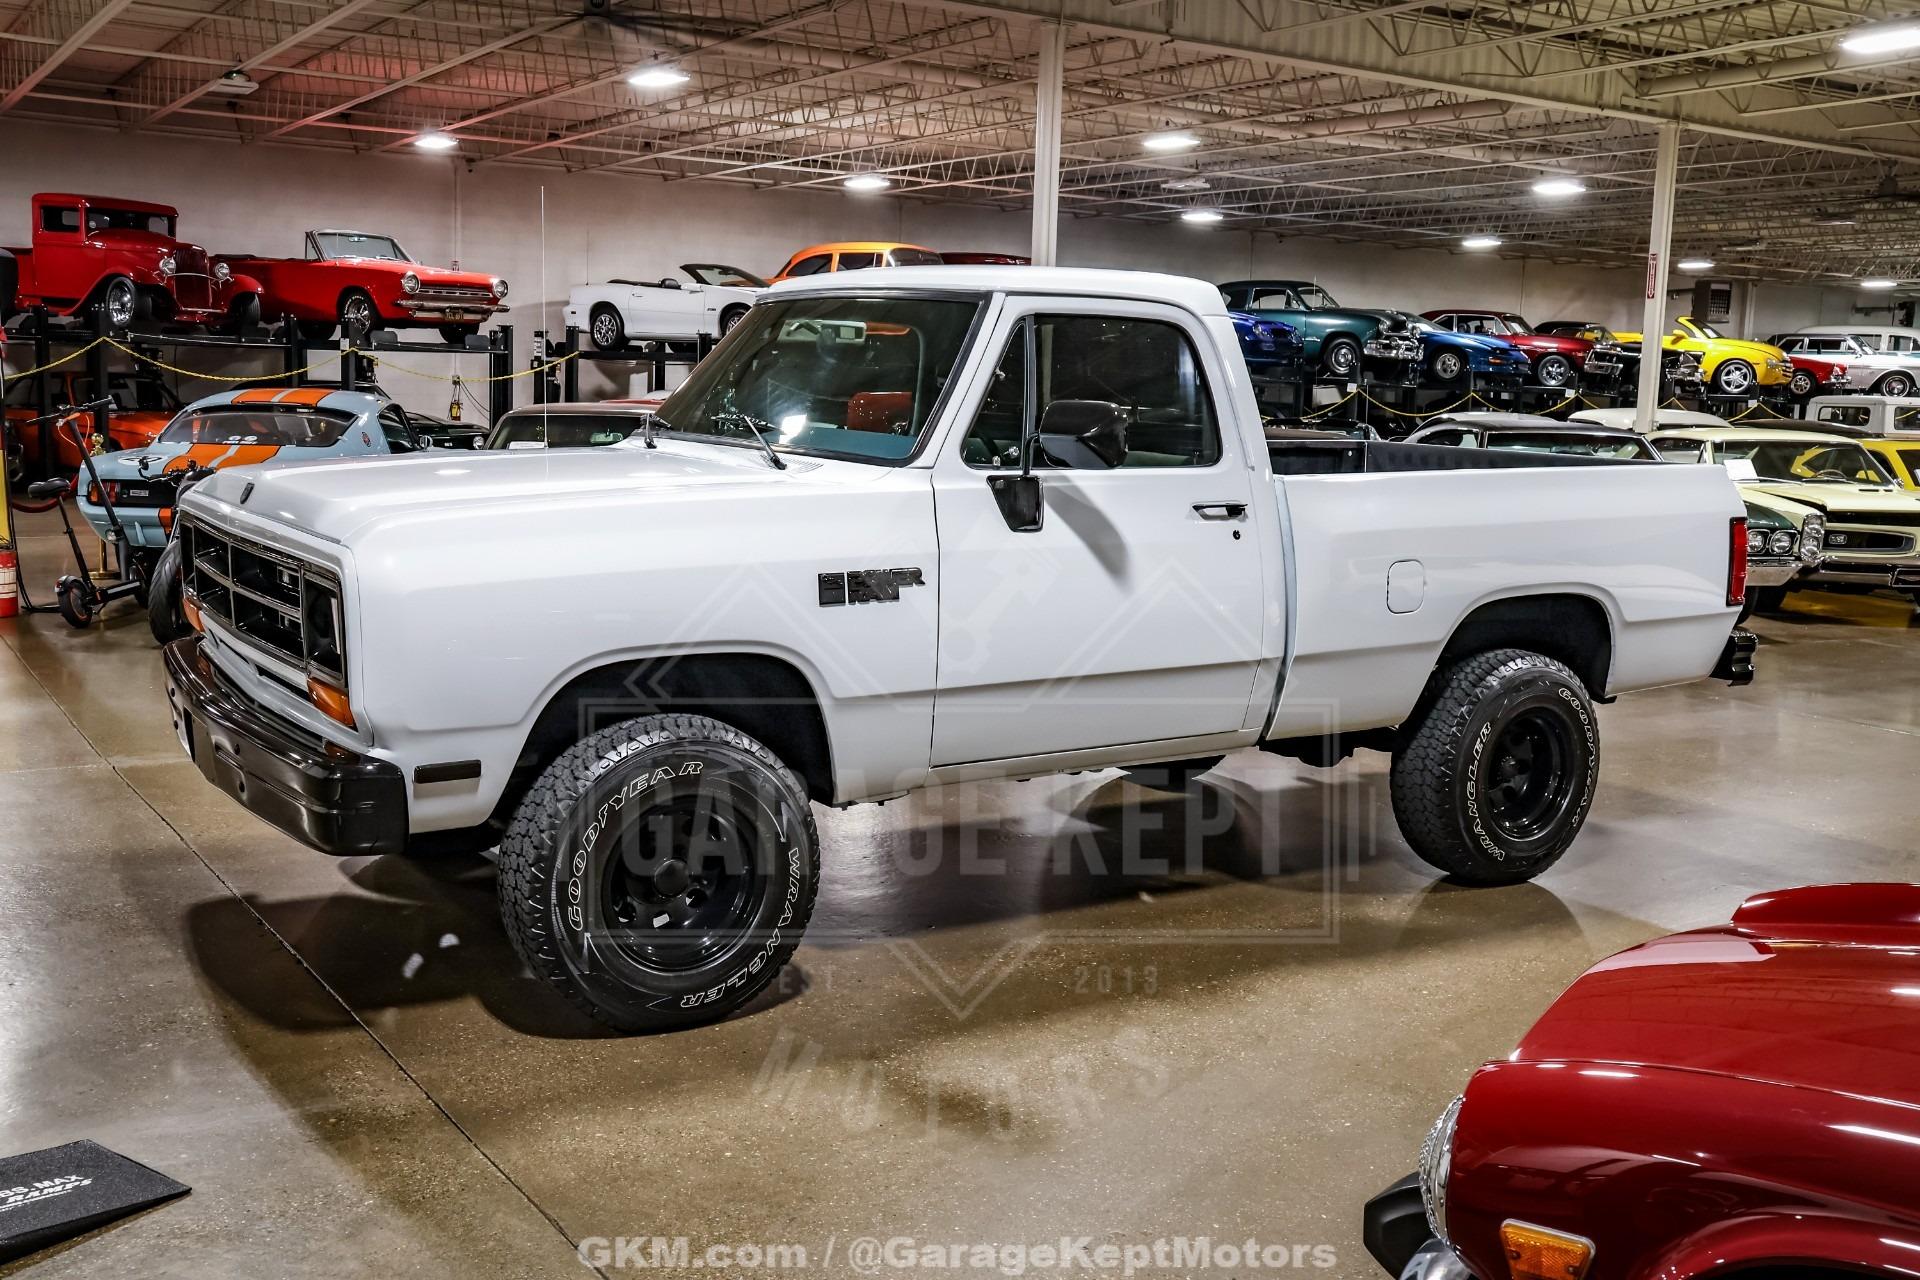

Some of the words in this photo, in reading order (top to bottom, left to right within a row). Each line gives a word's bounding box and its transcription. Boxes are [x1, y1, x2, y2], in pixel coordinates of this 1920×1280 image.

[1466, 721, 1505, 861] WRANGLER
[1558, 687, 1598, 827] GOODYEAR
[568, 761, 704, 931] GOODYEAR
[680, 847, 800, 1007] WRANGLER
[6, 1178, 93, 1204] RAMPS
